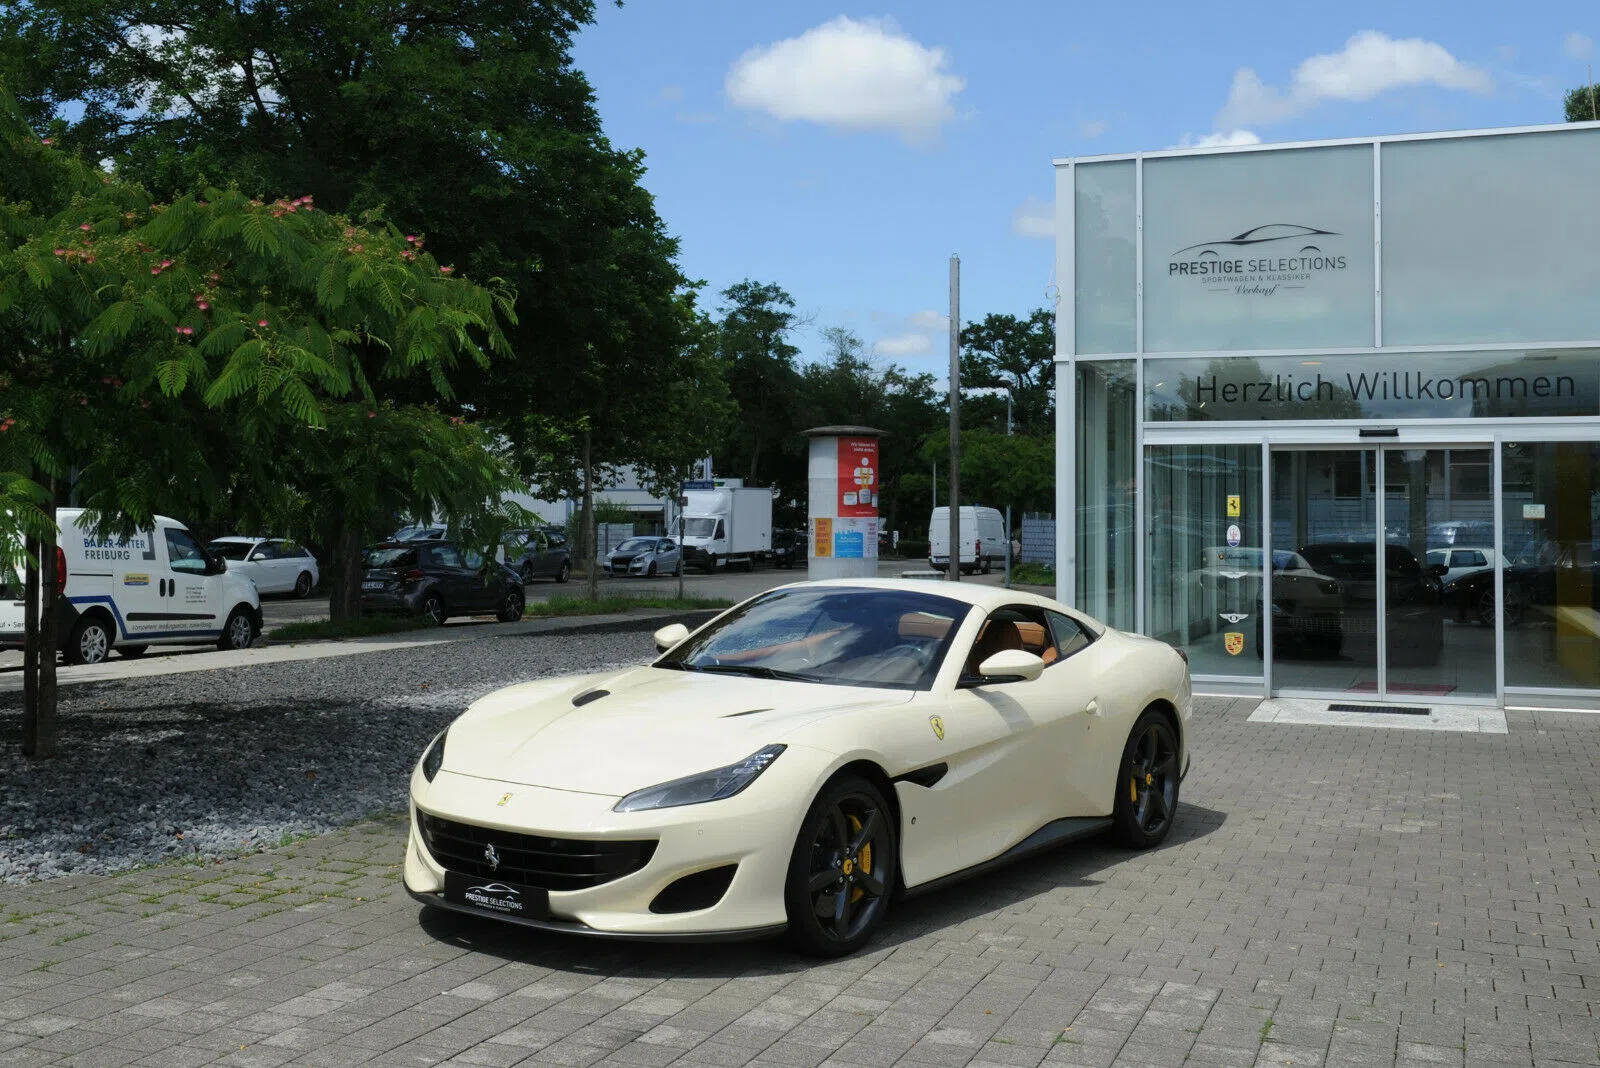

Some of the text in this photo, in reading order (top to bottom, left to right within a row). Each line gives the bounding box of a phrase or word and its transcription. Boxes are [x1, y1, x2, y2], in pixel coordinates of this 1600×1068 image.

[1169, 256, 1346, 275] PRESTIGE SELECTIONS
[1202, 274, 1255, 283] SPORTWAGEN
[1266, 273, 1311, 281] KLASSIKER
[1234, 283, 1280, 296] Verkauf
[1197, 371, 1575, 402] Herzlich Willkommen
[85, 550, 130, 560] FREIBURG
[465, 892, 489, 903] PRESTIGE
[490, 898, 522, 909] SELECTIONS
